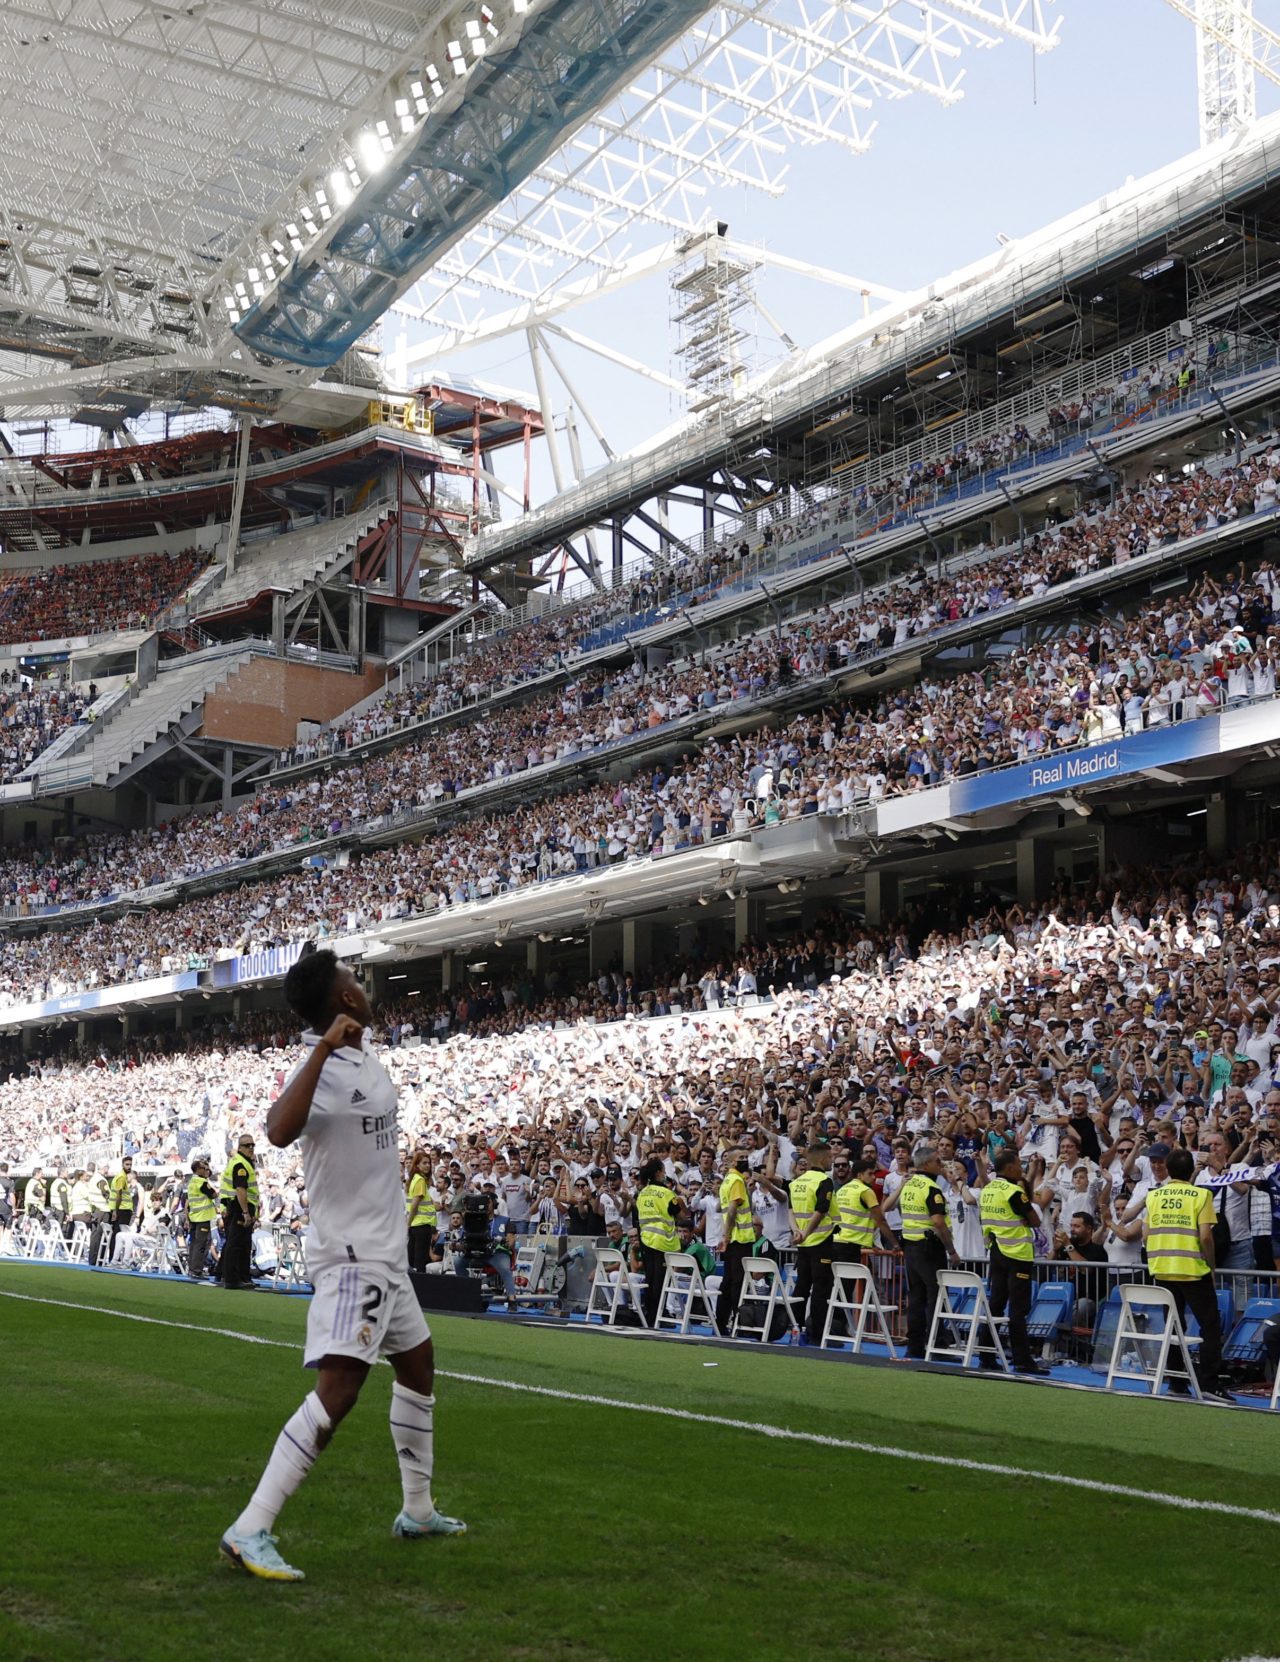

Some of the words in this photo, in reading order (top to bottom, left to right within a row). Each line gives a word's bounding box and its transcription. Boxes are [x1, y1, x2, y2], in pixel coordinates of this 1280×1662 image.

[1032, 764, 1063, 787] Real
[1067, 750, 1117, 778] Madrid
[1153, 1188, 1199, 1198] STEWARD
[1161, 1198, 1183, 1209] 256
